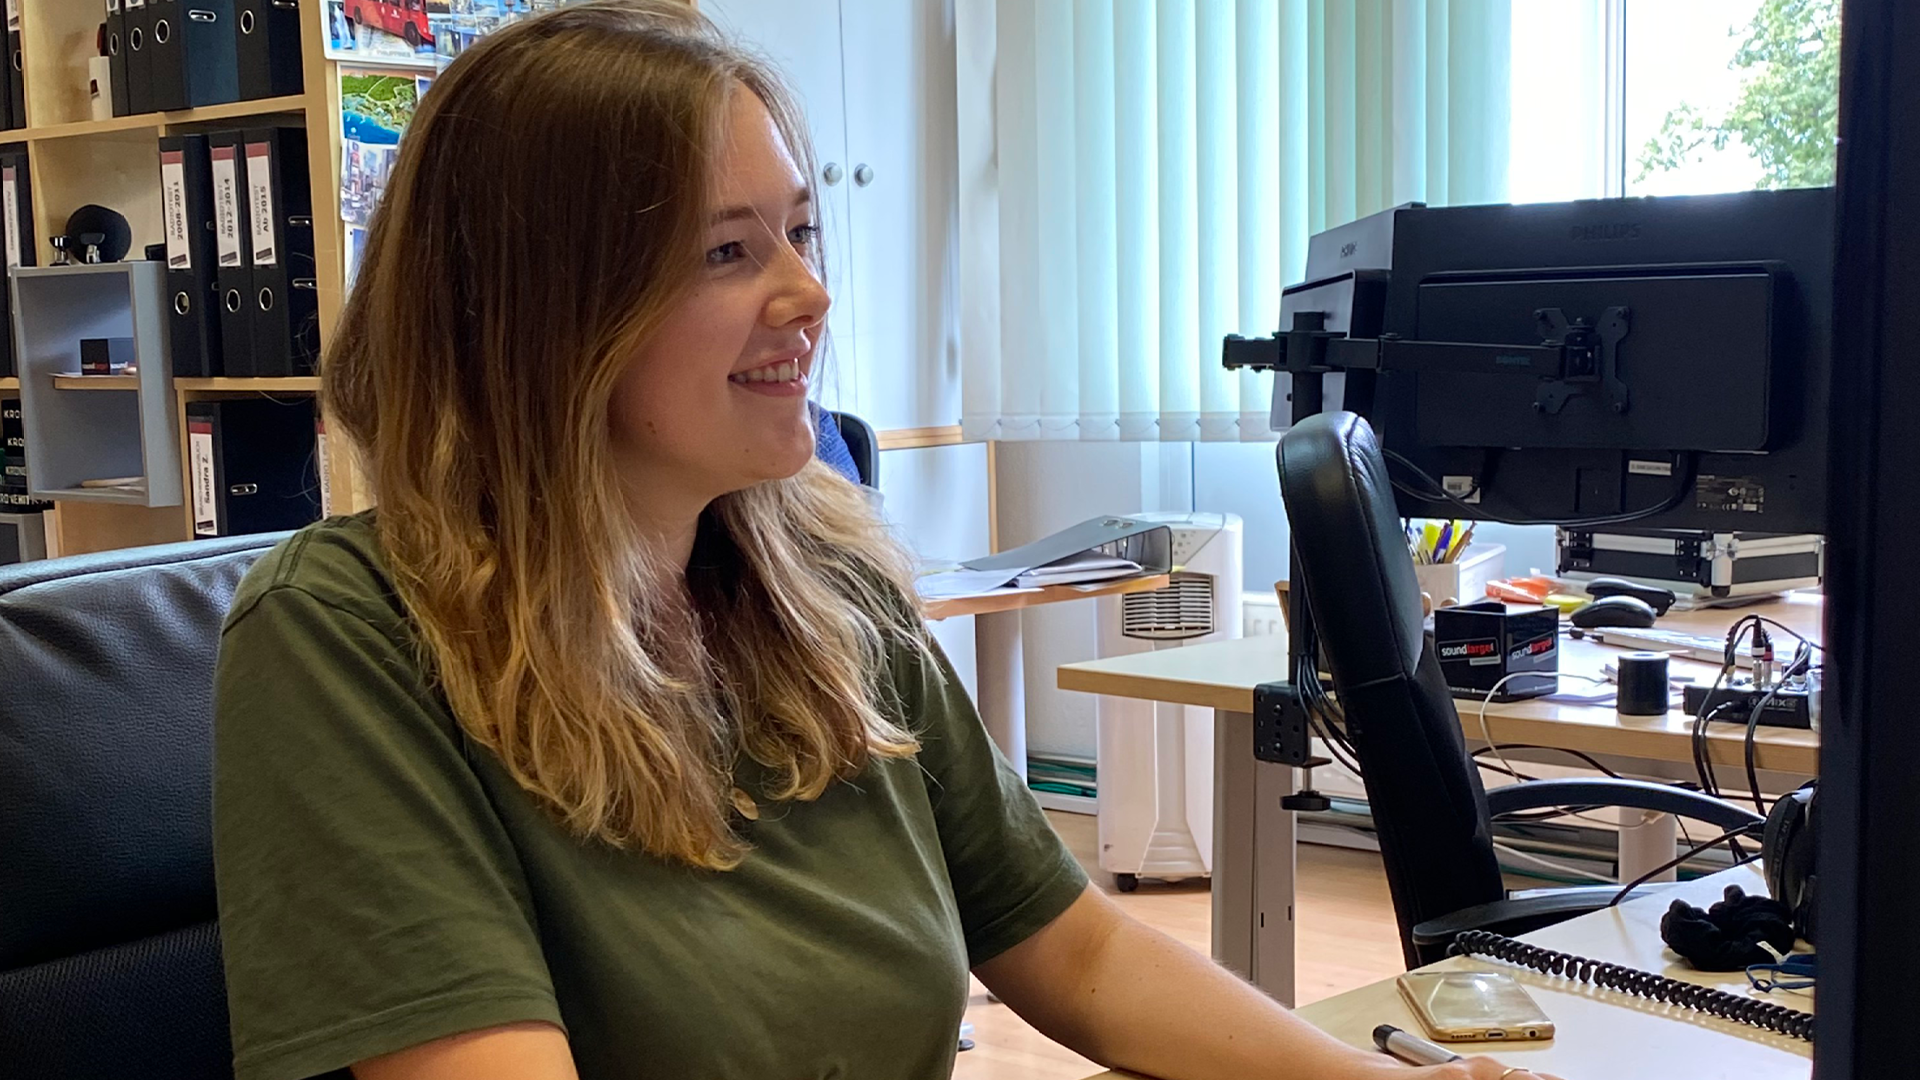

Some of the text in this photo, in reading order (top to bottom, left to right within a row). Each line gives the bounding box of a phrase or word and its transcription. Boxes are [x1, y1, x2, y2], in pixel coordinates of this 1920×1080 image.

[167, 186, 175, 236] RADIOTEST
[174, 181, 183, 240] 2008-2011
[218, 184, 226, 234] RADIOTEST
[224, 178, 233, 239] 2012-2014
[263, 217, 269, 232] Ab
[1572, 223, 1641, 240] PHILIPS
